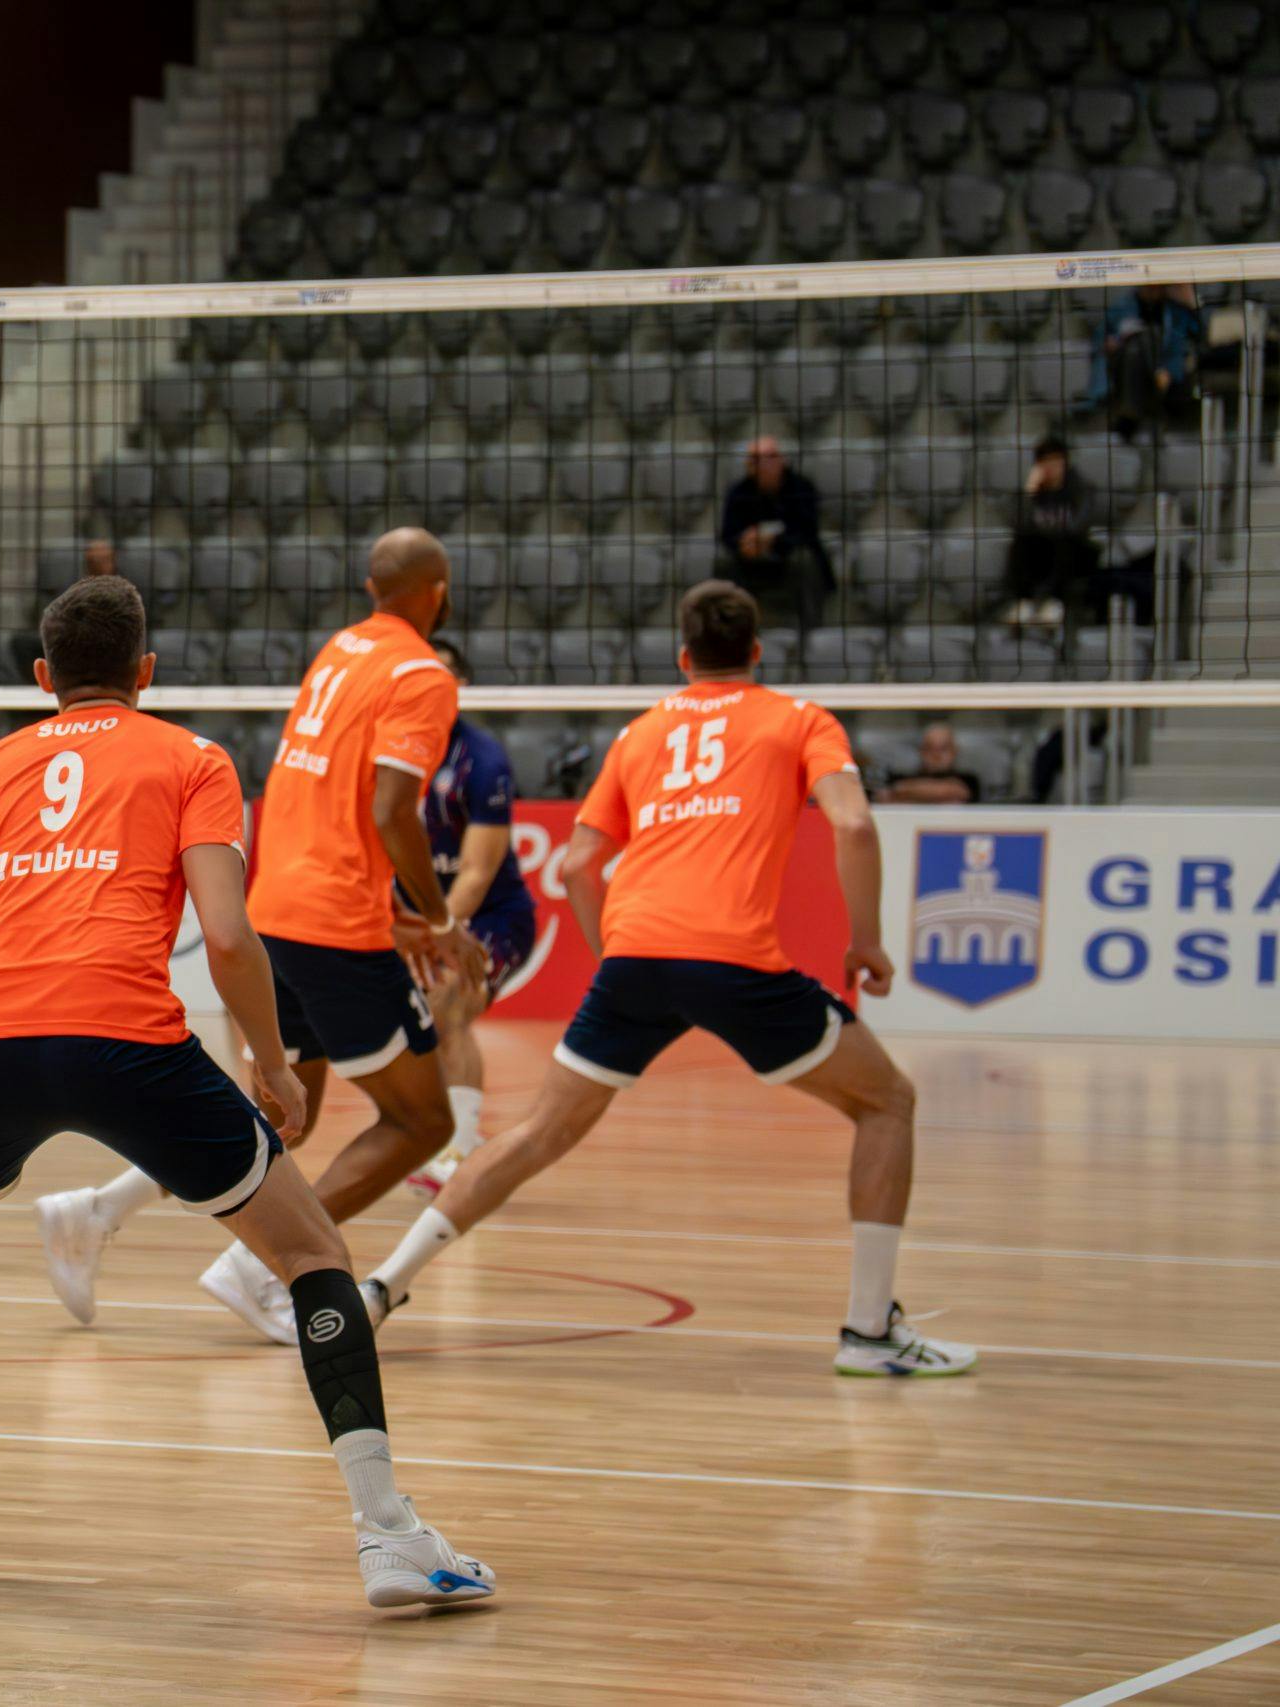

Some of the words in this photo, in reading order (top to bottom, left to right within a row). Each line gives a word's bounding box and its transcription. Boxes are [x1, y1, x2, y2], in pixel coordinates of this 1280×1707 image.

[295, 664, 348, 737] 11
[662, 716, 728, 791] 15
[39, 750, 84, 832] 9
[659, 794, 742, 824] cubus
[11, 842, 119, 877] cubus
[1083, 926, 1278, 987] OSI
